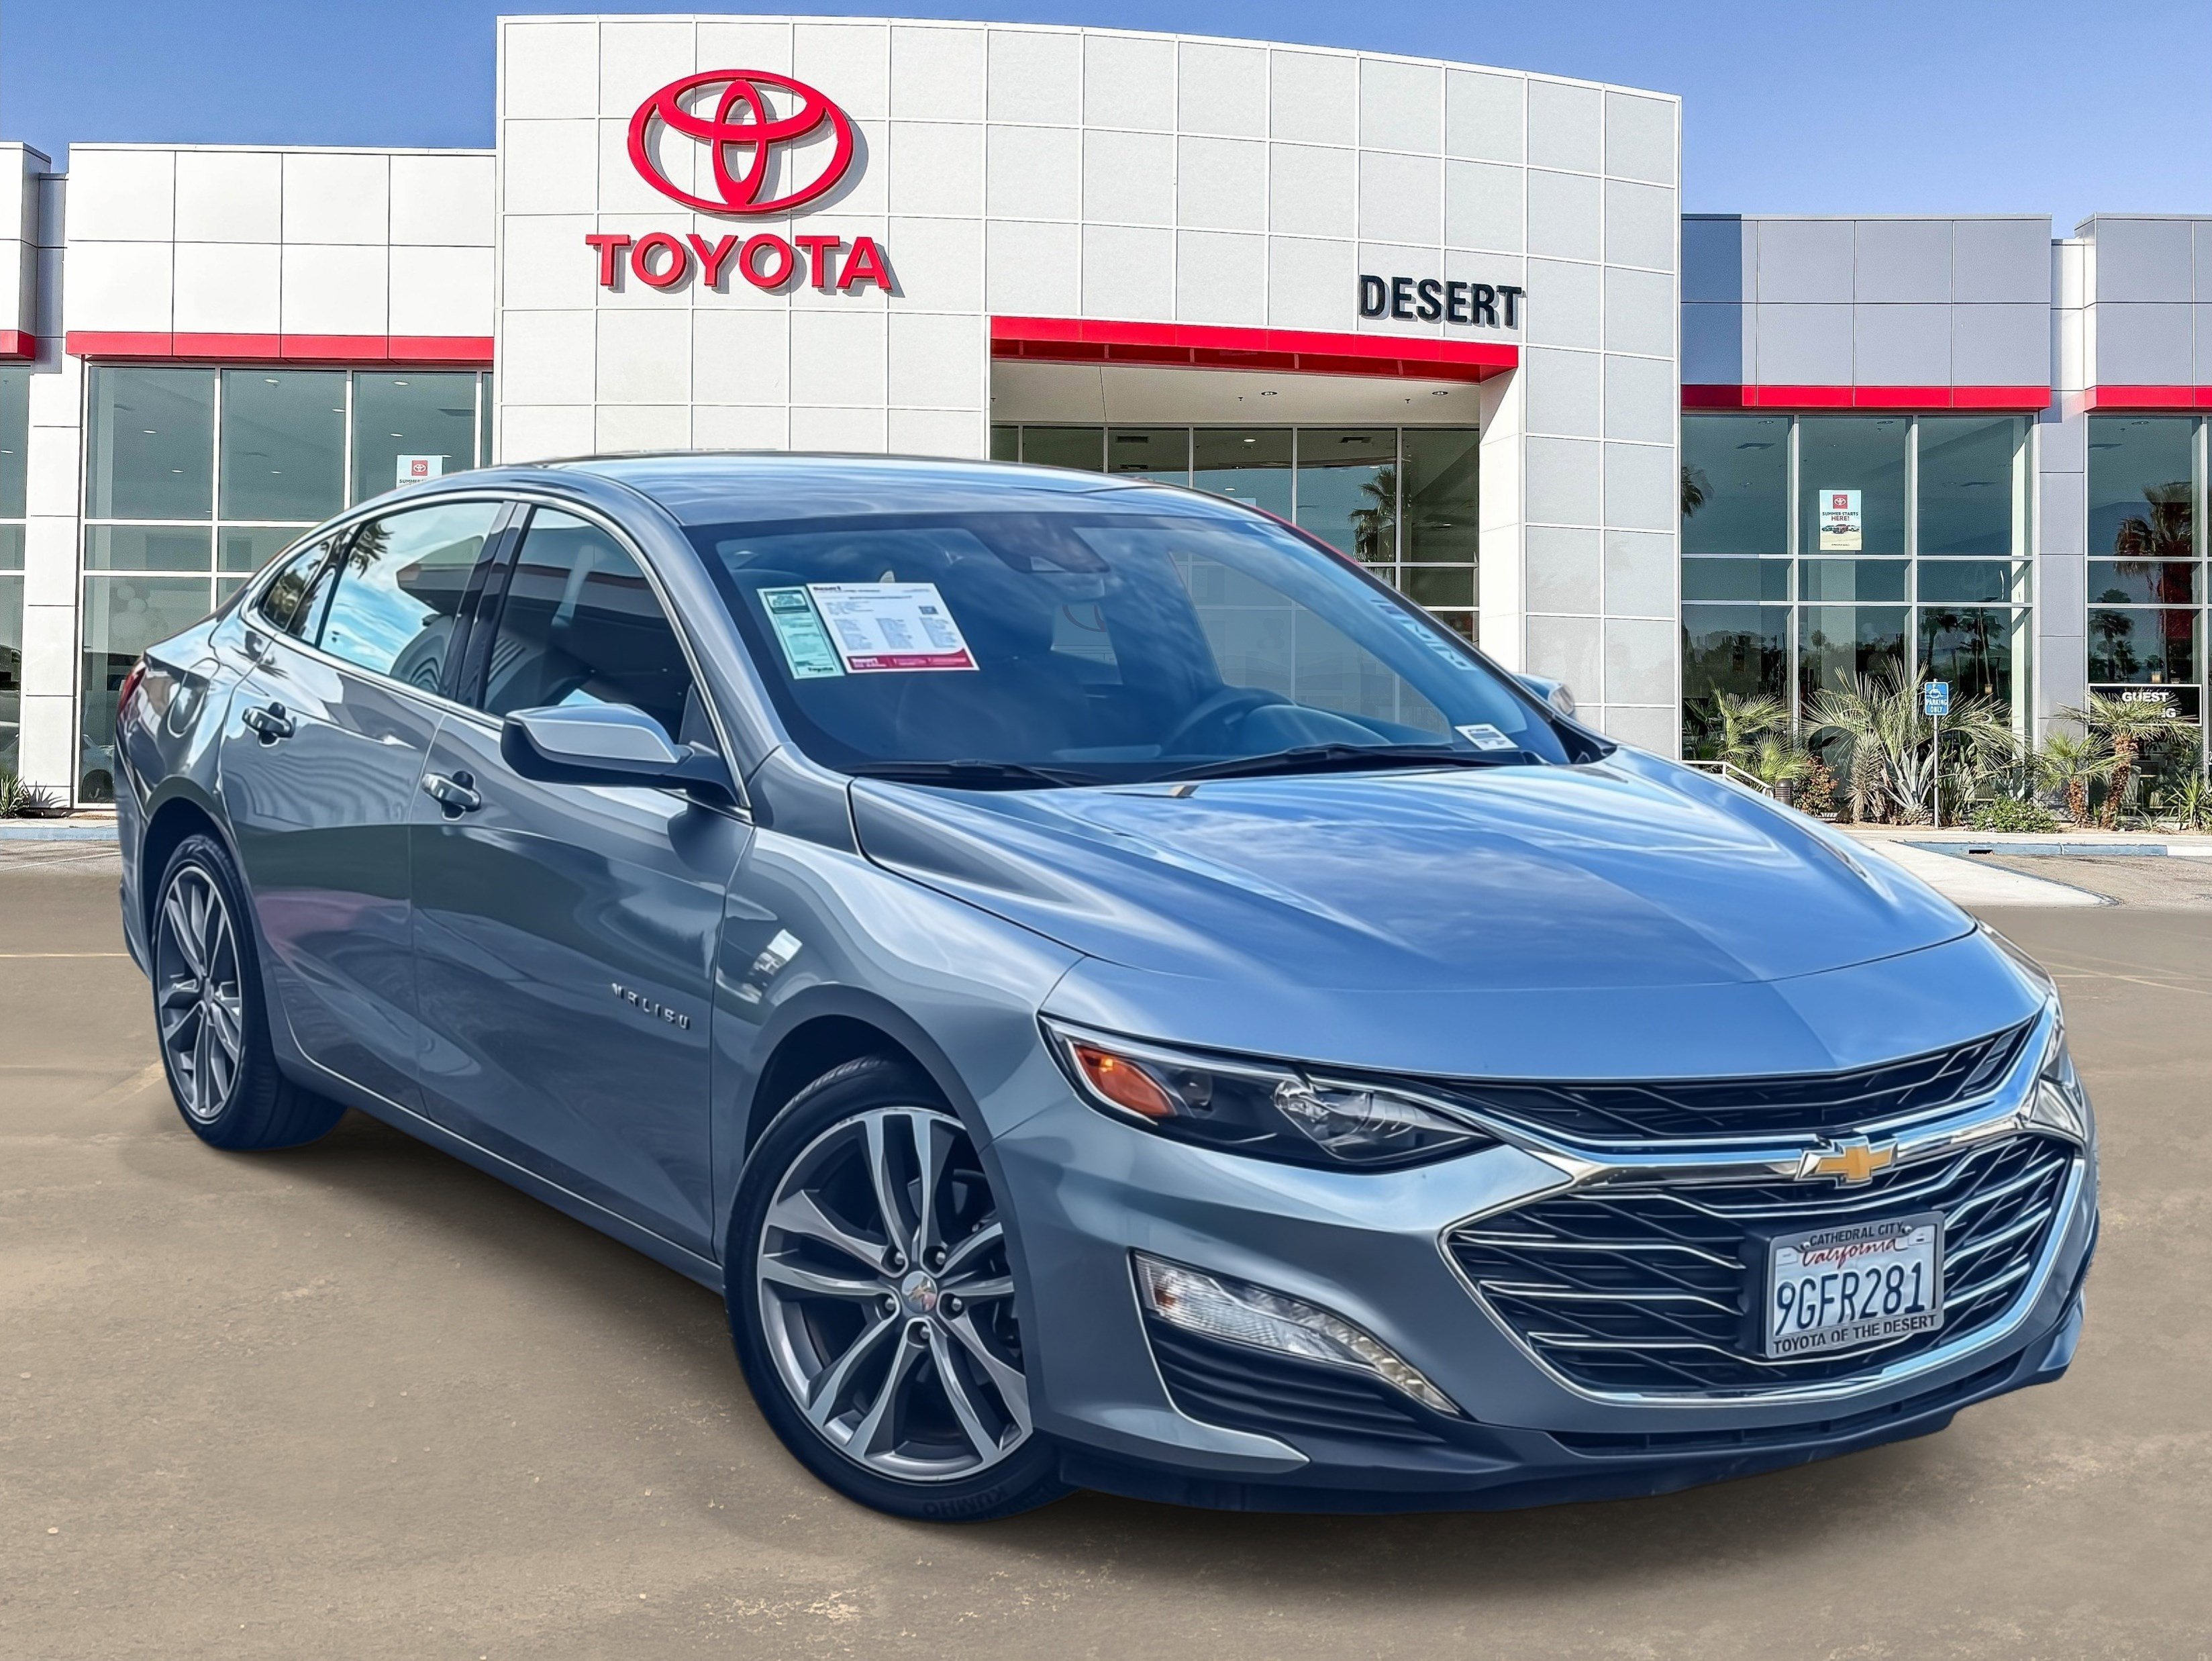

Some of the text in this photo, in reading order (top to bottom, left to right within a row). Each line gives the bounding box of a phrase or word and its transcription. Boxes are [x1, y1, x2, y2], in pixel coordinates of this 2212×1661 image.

[585, 232, 892, 291] TOYOTA
[1359, 274, 1522, 326] DESERT
[1930, 705, 1944, 713] ONLY
[2121, 691, 2169, 703] GUEST
[1809, 1221, 1904, 1246] CATHEDRAL CITY
[1802, 1238, 1908, 1269] California
[1775, 1260, 1925, 1336] 9GFR281
[1773, 1314, 1938, 1354] TOYOTA OF THE DESERT
[923, 1485, 1008, 1516] KUMHO
